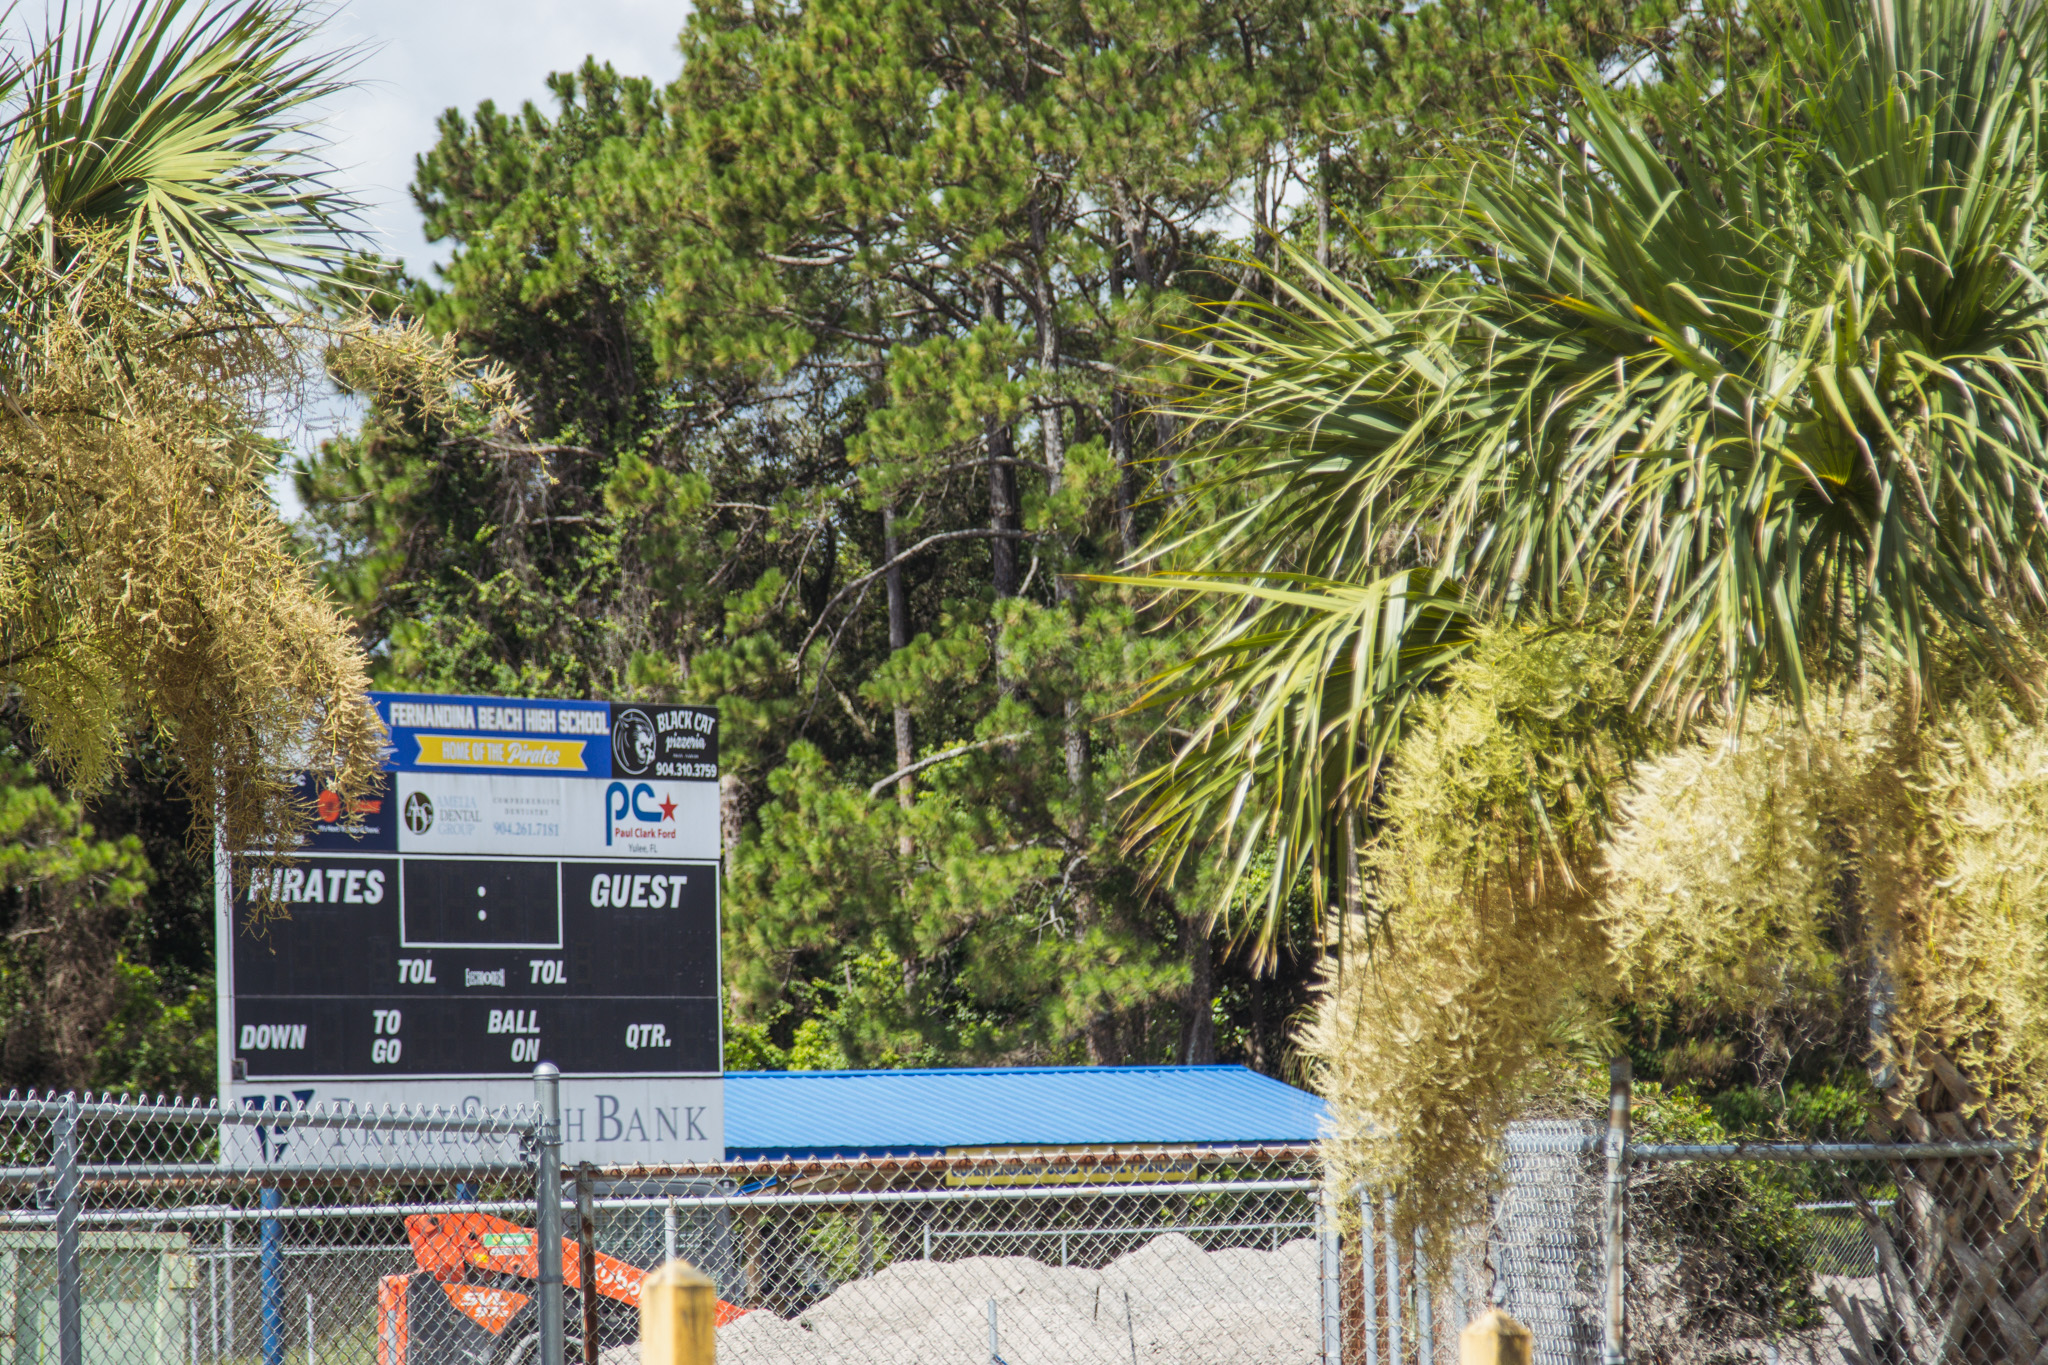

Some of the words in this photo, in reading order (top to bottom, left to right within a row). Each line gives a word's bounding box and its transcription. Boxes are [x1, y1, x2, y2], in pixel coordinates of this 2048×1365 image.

[390, 702, 476, 729] FERNANDINA
[478, 706, 523, 731] BEACH
[525, 708, 557, 733] HIGH
[558, 709, 610, 735] SCHOOL
[656, 710, 693, 733] BLACK
[693, 712, 716, 735] CAT
[442, 741, 471, 760] HOME
[472, 742, 484, 761] OF
[486, 743, 505, 762] THE
[507, 742, 560, 765] Pirates
[665, 731, 706, 753] pizzeria
[655, 762, 718, 778] 904.310.3759
[436, 796, 477, 808] AMELIA
[440, 810, 482, 822] DENTAL
[437, 823, 476, 836] GROUP
[493, 822, 559, 836] 904.261.7181
[615, 828, 633, 838] Paul
[634, 828, 656, 838] Clark
[657, 829, 676, 839] Ford
[247, 867, 386, 905] PIRATES
[590, 873, 688, 909] GUEST
[397, 958, 437, 985] TOL
[529, 960, 567, 985] TOL
[372, 1010, 402, 1035] TO
[487, 1010, 541, 1035] BALL
[239, 1024, 307, 1051] DOWN
[625, 1024, 672, 1050] QTR.
[371, 1039, 402, 1064] GO
[510, 1039, 541, 1063] ON
[332, 1095, 585, 1147] PRIMESOH
[595, 1095, 708, 1142] BANK
